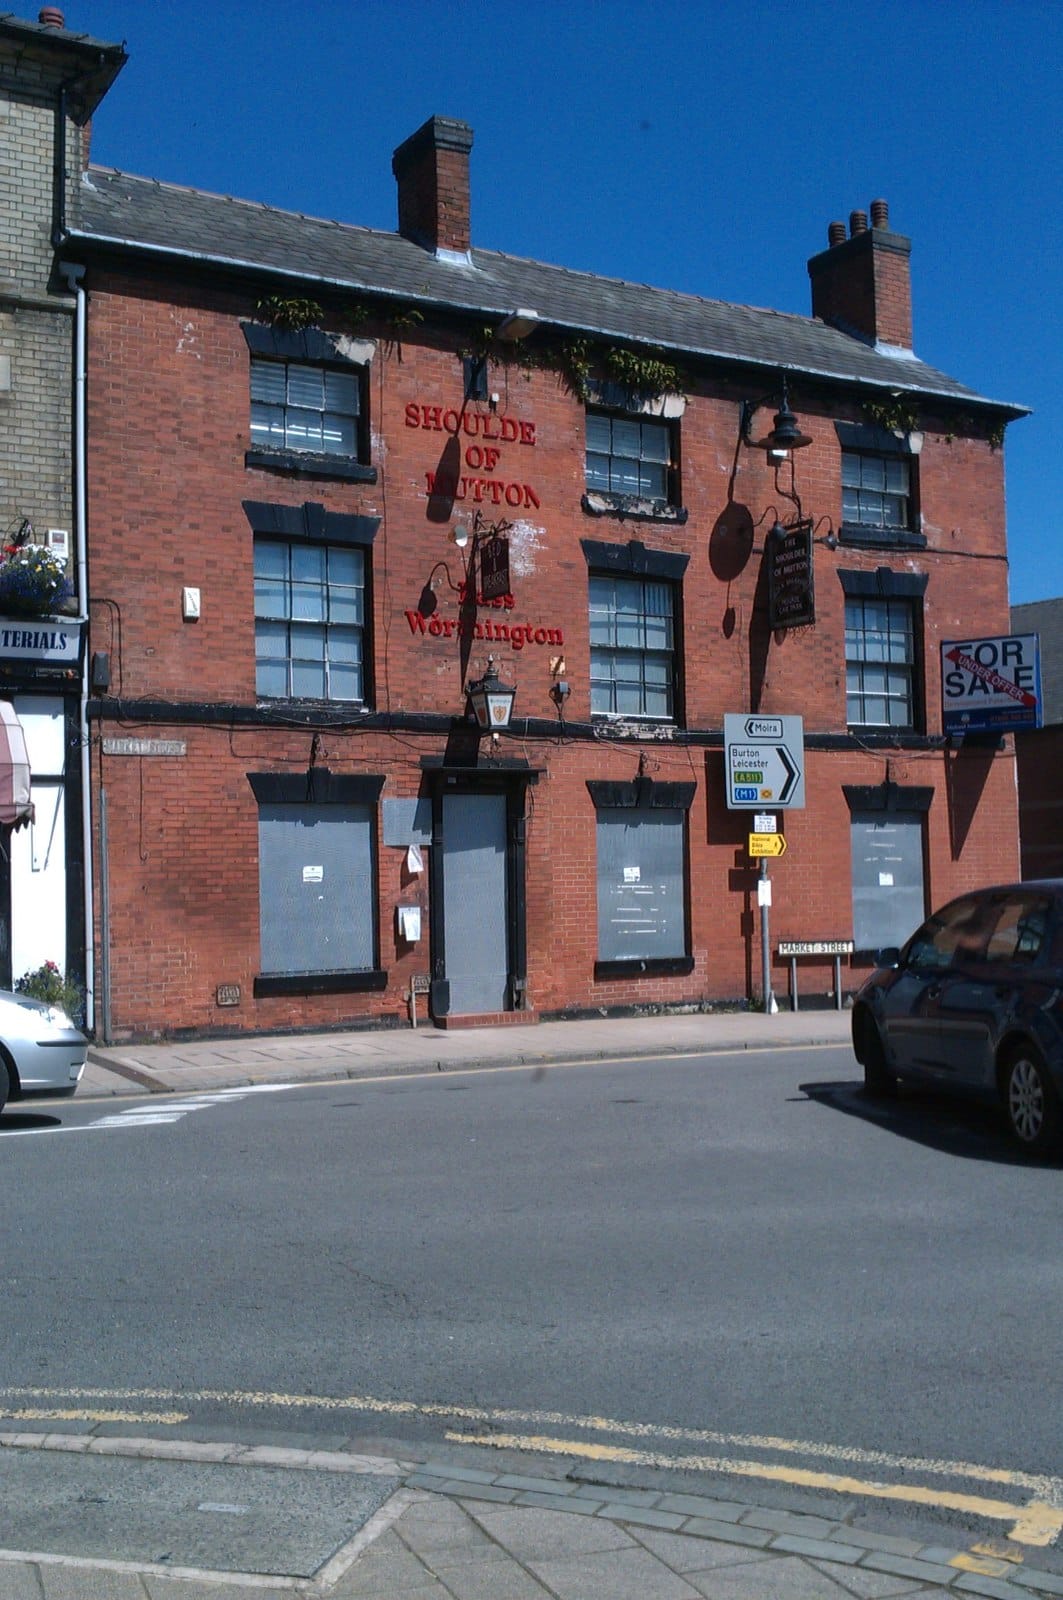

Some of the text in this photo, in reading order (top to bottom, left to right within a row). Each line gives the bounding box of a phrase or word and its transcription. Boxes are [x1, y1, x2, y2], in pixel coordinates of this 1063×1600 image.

[405, 403, 536, 445] SHOULDE
[465, 445, 500, 471] OF
[2, 630, 68, 650] TERIALS
[955, 641, 1023, 670] FOR
[958, 655, 1024, 700] UNDER OFFER
[755, 723, 777, 732] Moira
[732, 748, 760, 757] Burton
[733, 759, 768, 768] Leicester
[781, 942, 850, 952] MARKET STREET
